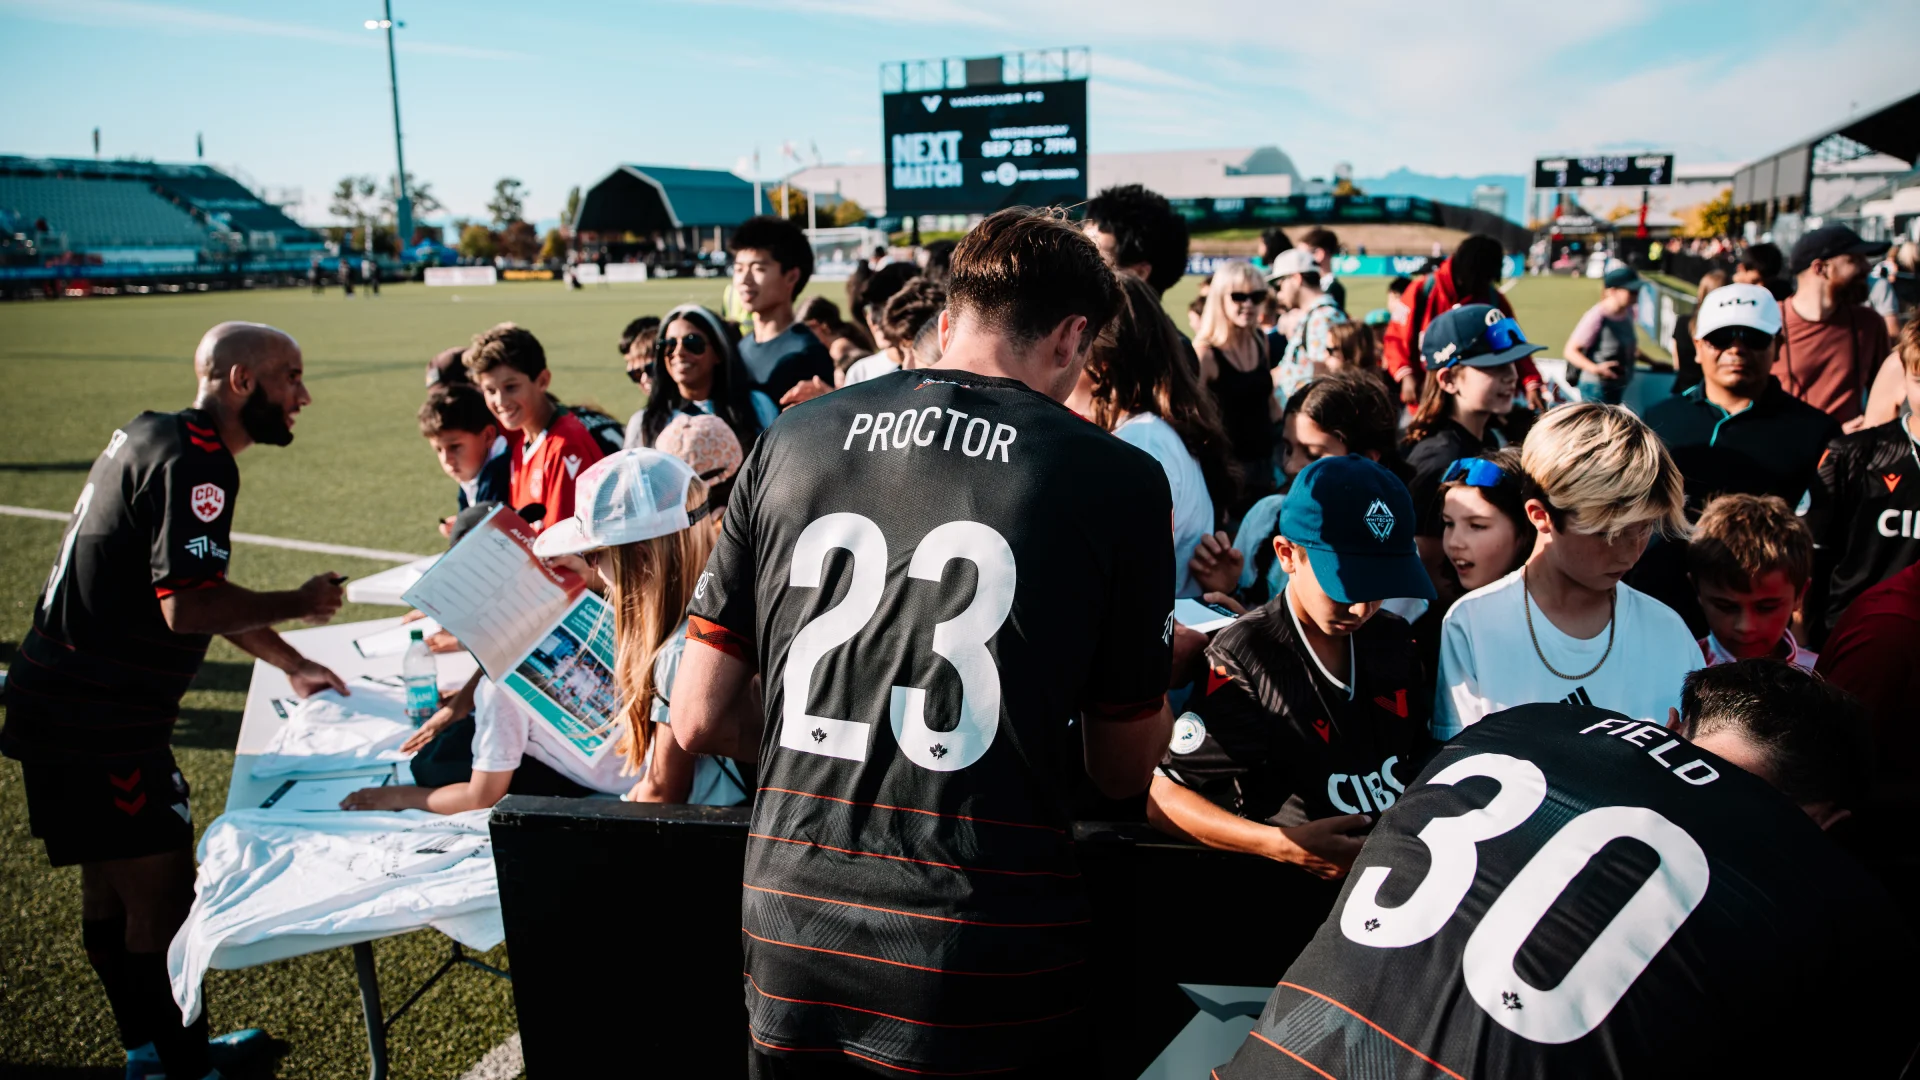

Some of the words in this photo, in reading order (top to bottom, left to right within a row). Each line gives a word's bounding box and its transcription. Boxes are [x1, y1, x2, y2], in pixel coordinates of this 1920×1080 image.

[892, 131, 963, 163] NEXT
[893, 162, 963, 189] MATCH
[843, 406, 1018, 463] PROCTOR
[195, 486, 222, 503] CPL
[1877, 509, 1920, 540] CI
[780, 512, 1017, 772] 23
[1579, 718, 1720, 785] FIELD
[1327, 755, 1405, 814] CIBC
[1340, 752, 1710, 1044] 30
